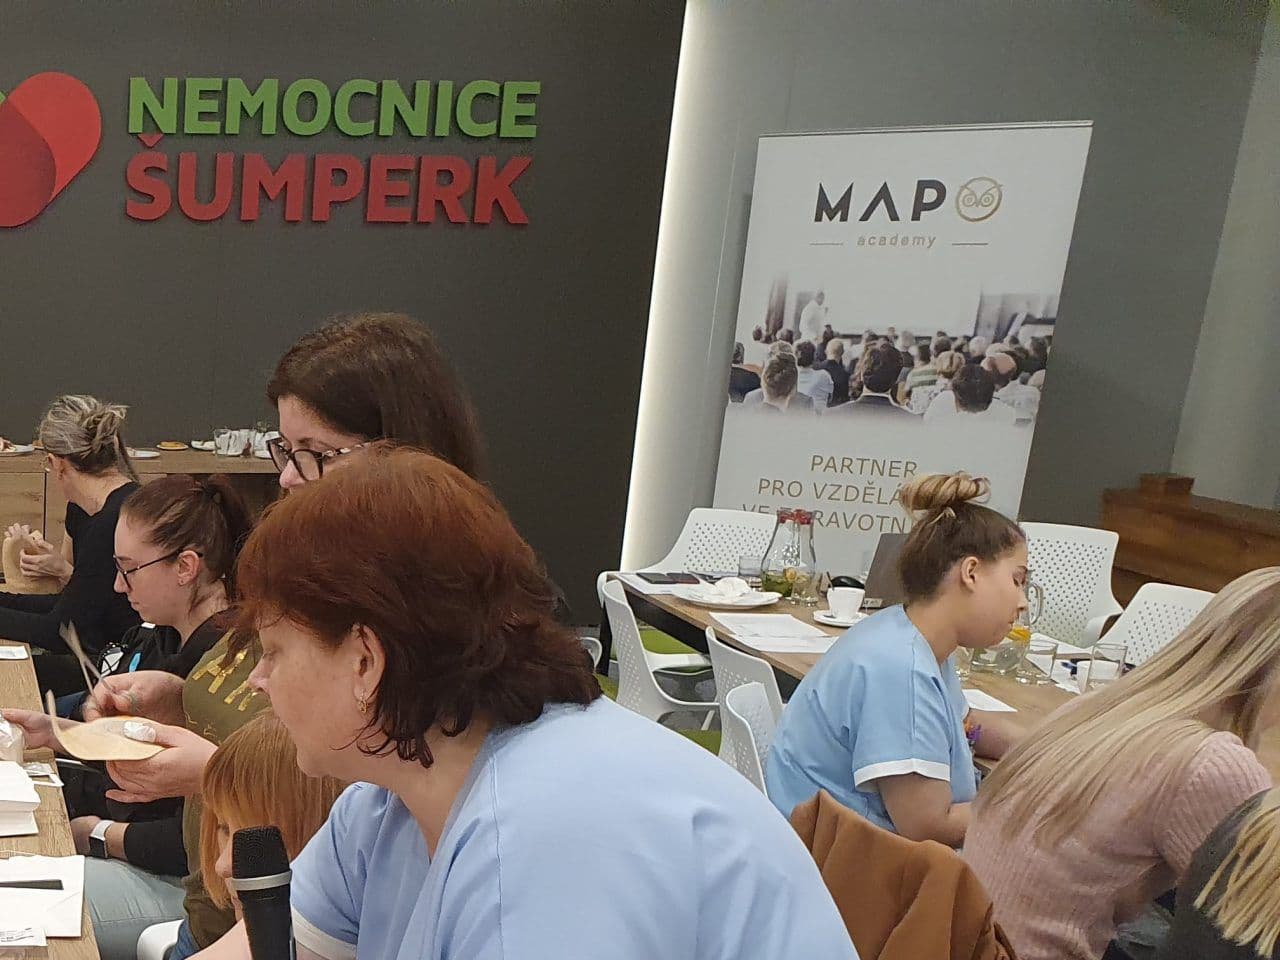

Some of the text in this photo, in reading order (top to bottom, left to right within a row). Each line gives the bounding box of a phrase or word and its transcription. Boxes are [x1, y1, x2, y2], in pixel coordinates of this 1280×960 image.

[128, 76, 541, 138] NEMOCNICE
[125, 133, 533, 225] ŠUMPERK
[857, 233, 936, 249] academy
[811, 455, 917, 477] PARTNER
[758, 478, 803, 498] PRO
